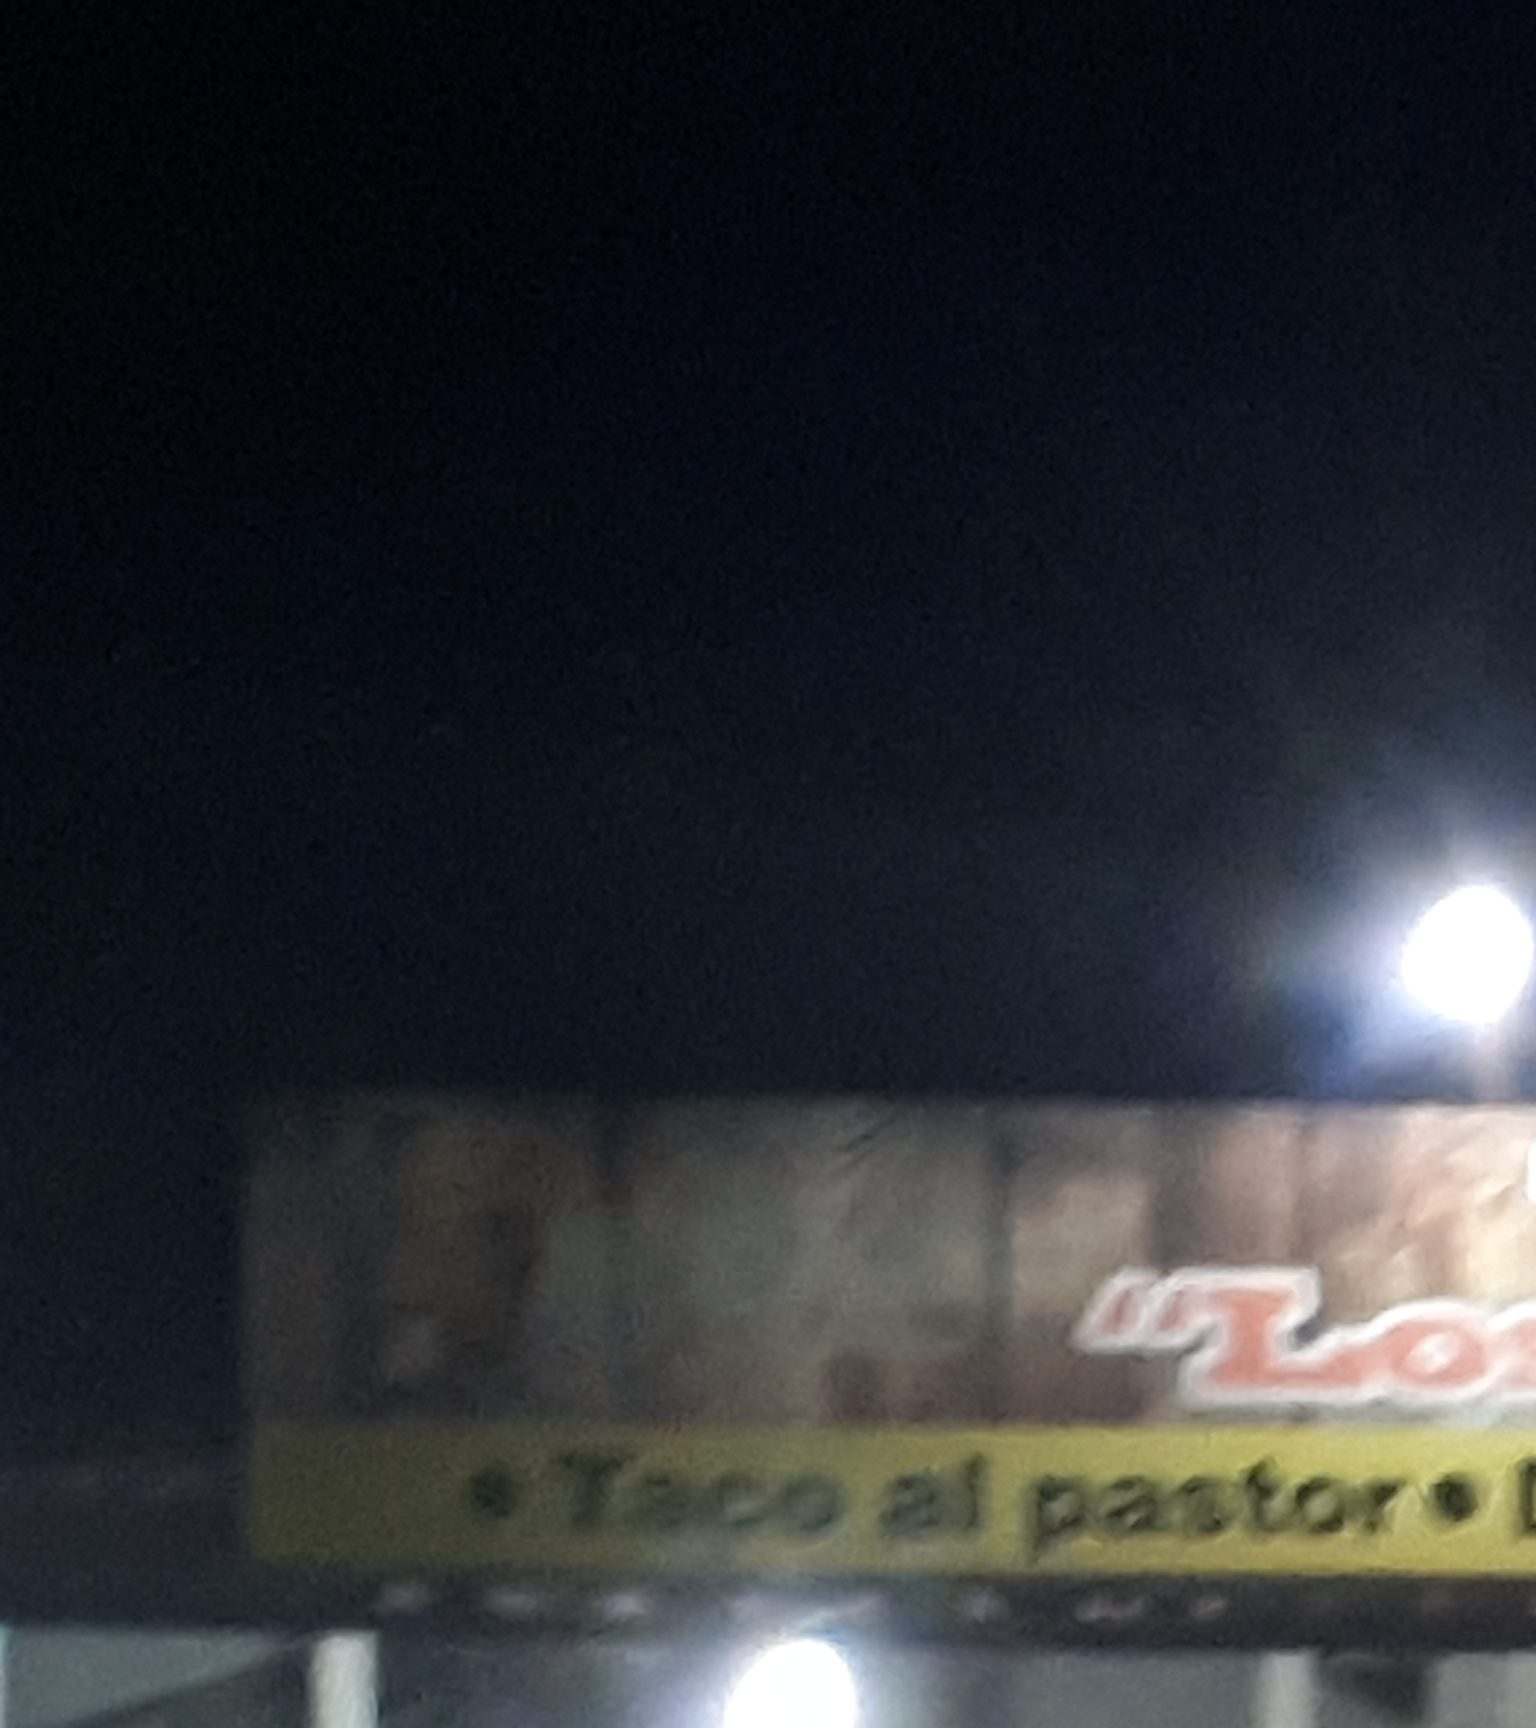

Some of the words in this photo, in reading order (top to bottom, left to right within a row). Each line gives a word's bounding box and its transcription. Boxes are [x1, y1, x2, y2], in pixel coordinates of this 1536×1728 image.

[553, 1448, 845, 1534] Taco
[883, 1450, 992, 1532] al
[1030, 1455, 1400, 1565] pastor
